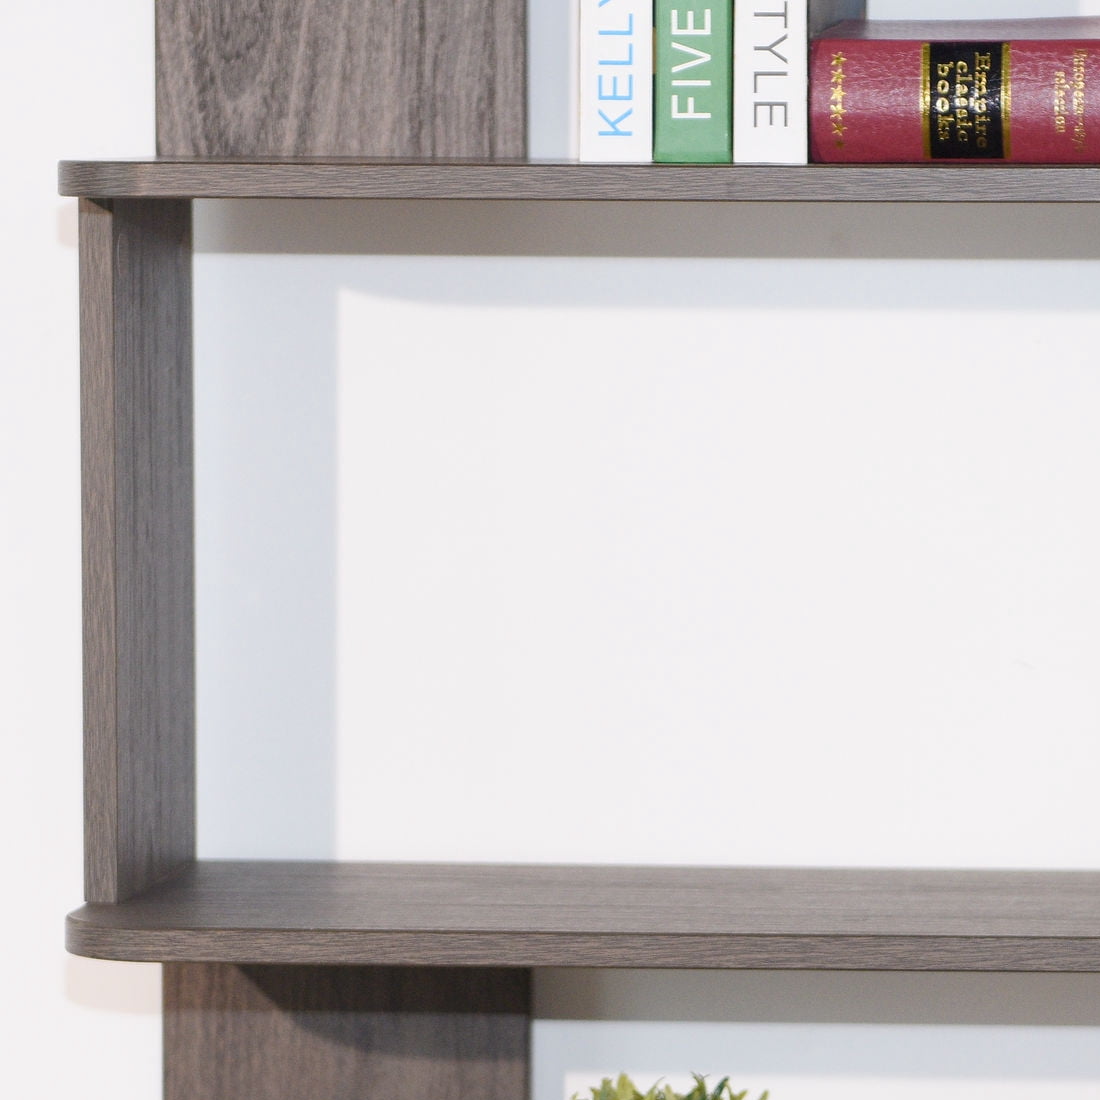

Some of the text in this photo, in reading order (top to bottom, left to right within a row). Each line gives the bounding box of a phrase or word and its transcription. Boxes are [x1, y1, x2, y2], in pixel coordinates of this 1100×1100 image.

[597, 0, 633, 136] KELL
[671, 8, 712, 119] FIVE
[753, 1, 789, 128] TYLE
[936, 61, 955, 140] books
[955, 60, 974, 143] classic
[970, 52, 992, 148] Empire
